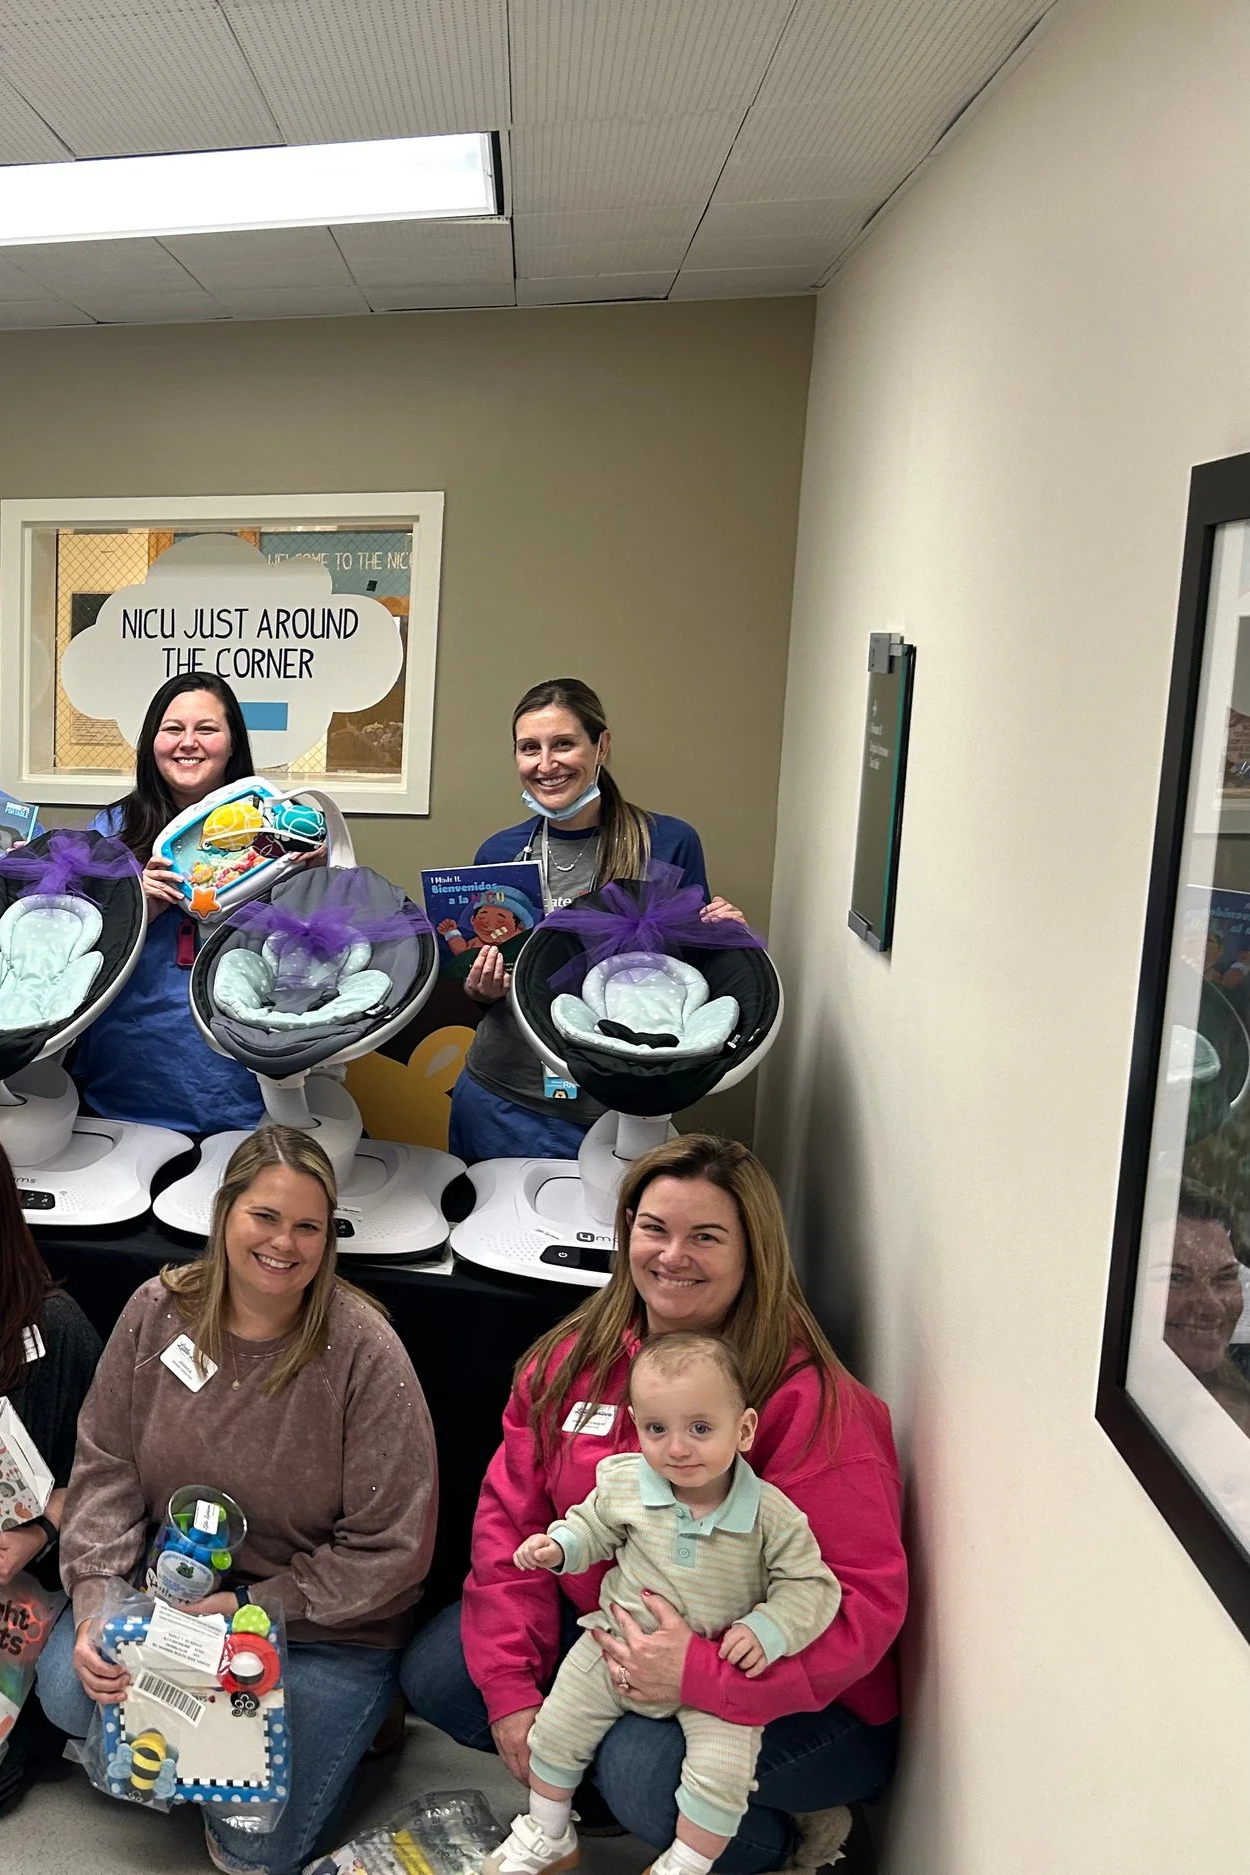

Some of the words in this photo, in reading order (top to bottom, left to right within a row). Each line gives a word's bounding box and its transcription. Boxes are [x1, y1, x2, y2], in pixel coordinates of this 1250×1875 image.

[335, 552, 352, 570] TO
[357, 552, 382, 570] THE
[387, 552, 411, 570] NIC
[122, 608, 175, 639] NICU
[183, 608, 249, 639] JUST
[256, 608, 359, 639] AROUND
[162, 648, 206, 678] THE
[216, 648, 315, 679] CORNER
[431, 882, 498, 894] Bienvenidos
[458, 896, 469, 905] la
